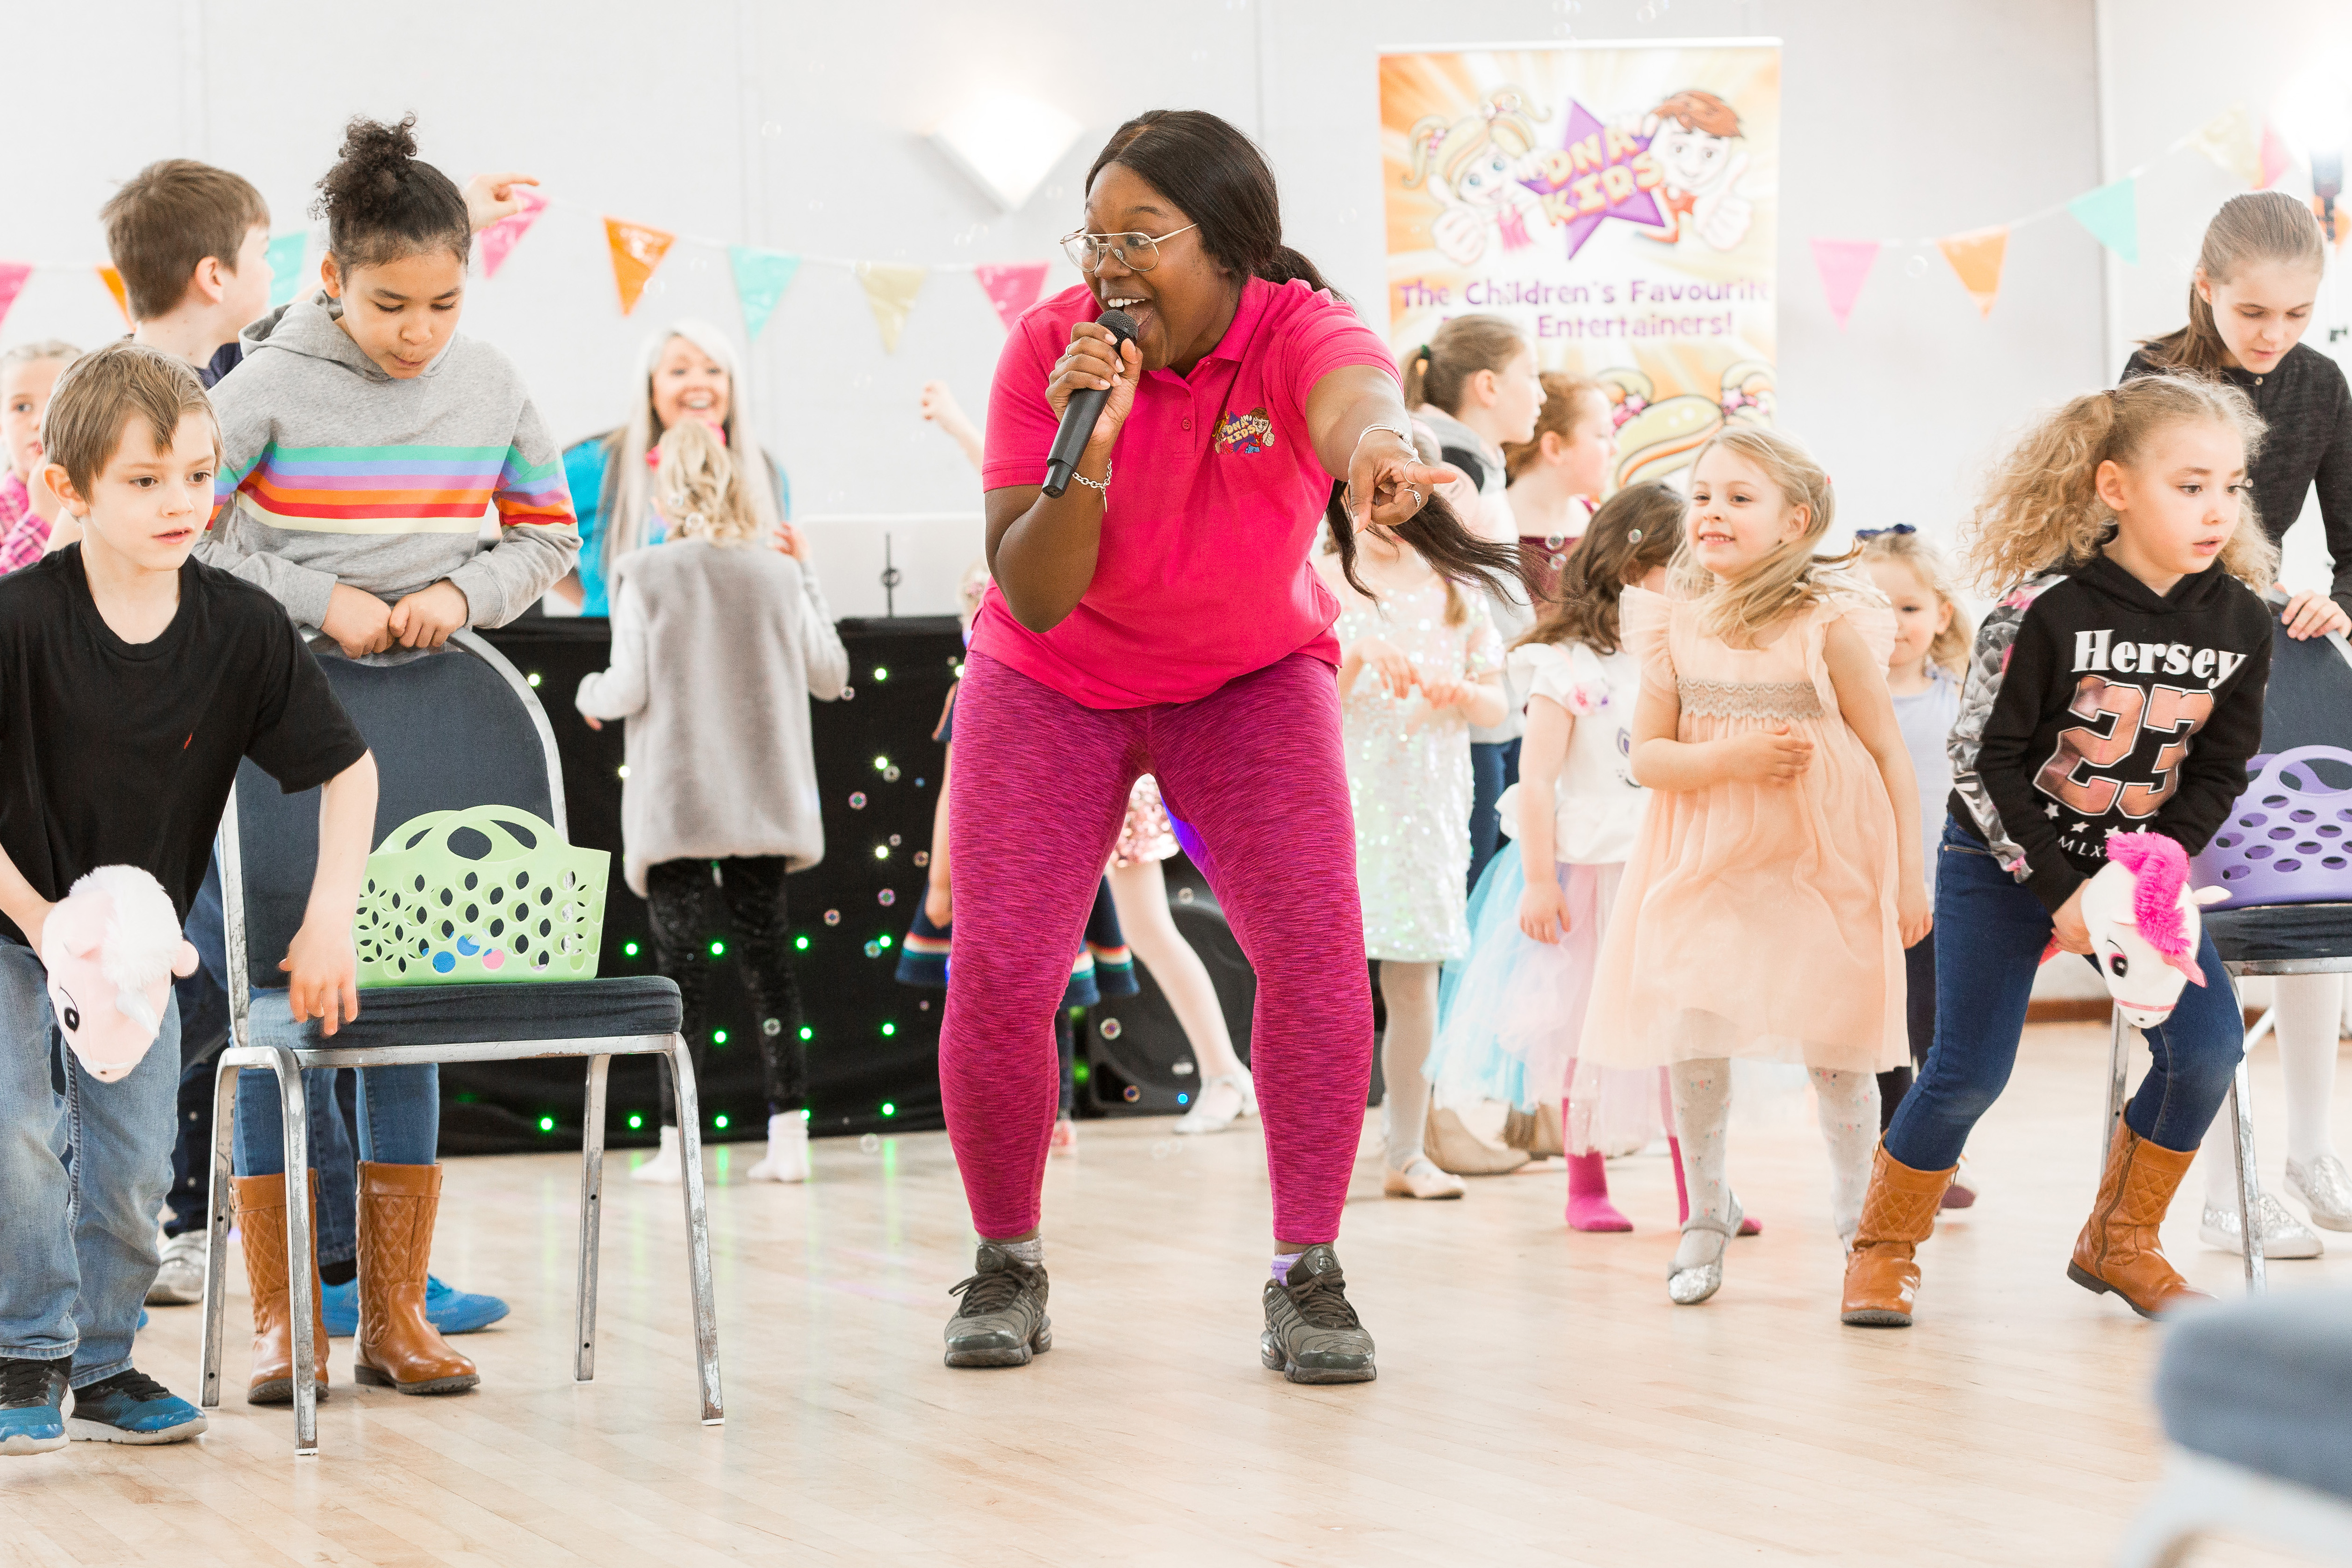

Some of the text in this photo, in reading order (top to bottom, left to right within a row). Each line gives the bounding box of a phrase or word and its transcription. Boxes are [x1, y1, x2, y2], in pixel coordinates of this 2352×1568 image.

[1546, 127, 1640, 190] DNA
[1540, 151, 1664, 226] KIDS
[1399, 279, 1449, 307] The
[1466, 279, 1615, 305] Children's
[1538, 311, 1732, 337] Entertainers!
[1226, 417, 1249, 434] DNA
[1227, 424, 1256, 444] KIDS
[2071, 629, 2247, 689] Hersey
[2034, 675, 2215, 819] 23
[2057, 835, 2107, 857] MLX
